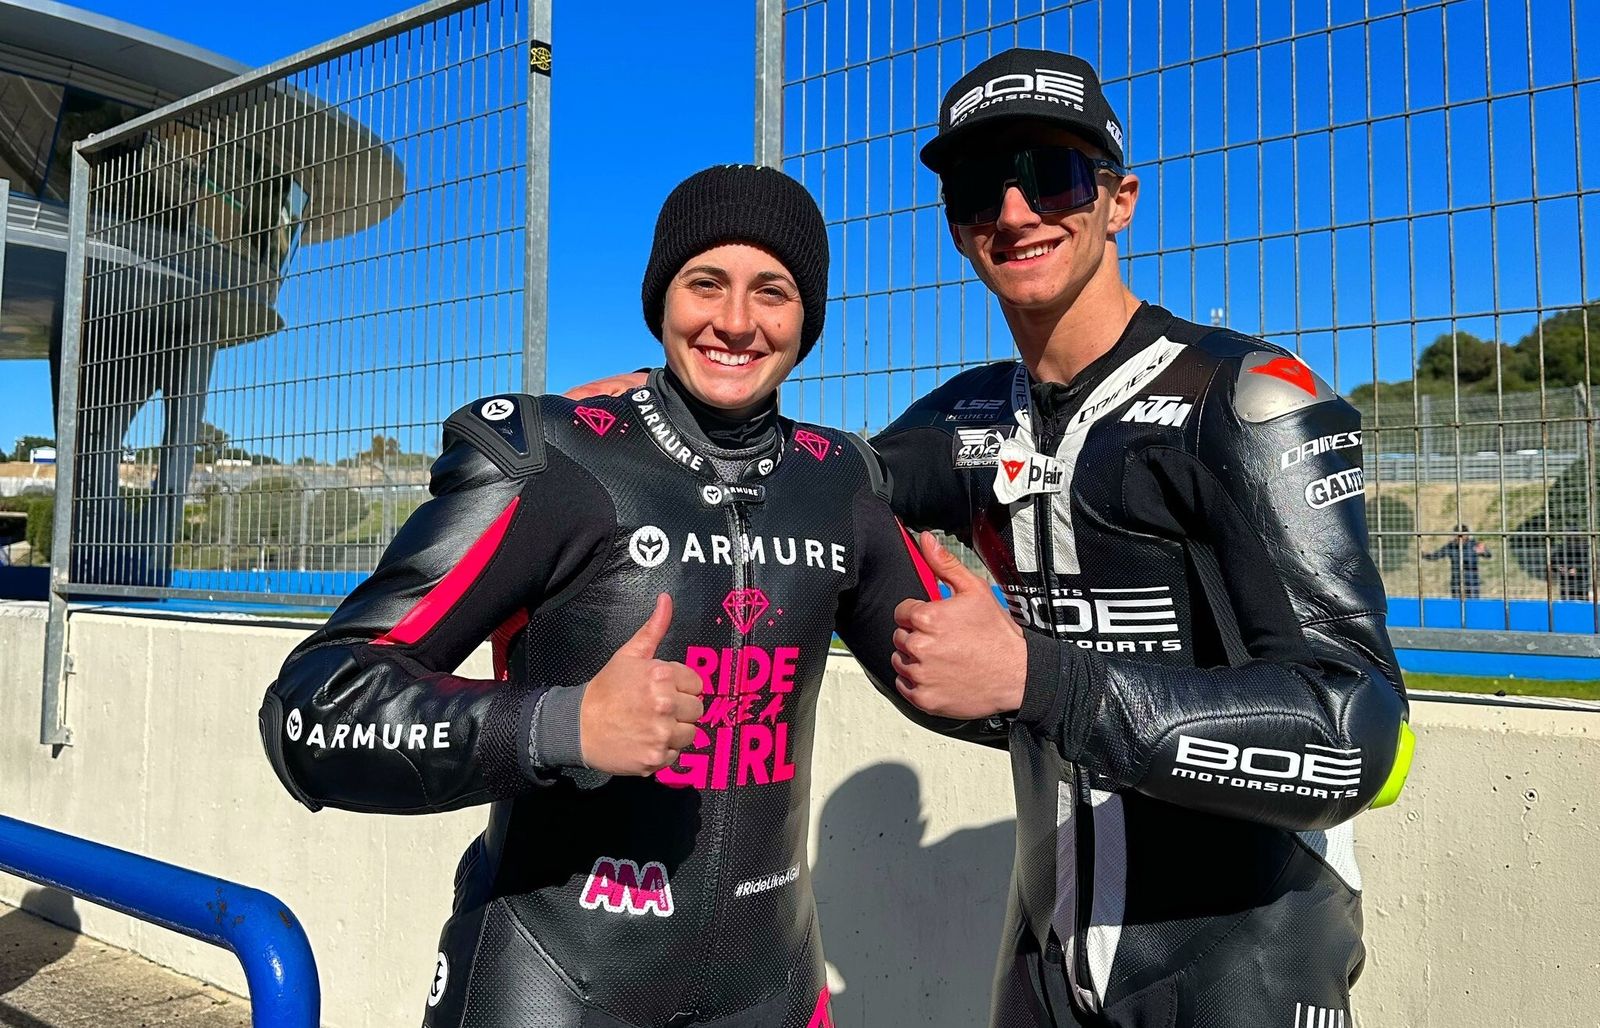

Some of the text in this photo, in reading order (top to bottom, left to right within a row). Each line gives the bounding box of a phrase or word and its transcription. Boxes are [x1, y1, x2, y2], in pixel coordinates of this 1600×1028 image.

[950, 69, 1085, 125] BOE
[953, 399, 1006, 410] LS2
[1121, 395, 1192, 427] KTM
[638, 402, 705, 472] ARMURE
[1281, 430, 1363, 470] DAINES
[724, 486, 759, 496] ARMURE
[681, 533, 847, 573] ARMURE
[686, 645, 800, 695] RIDE
[697, 693, 762, 728] IKE
[306, 721, 451, 750] ARMURE
[655, 722, 796, 789] GIRL
[1175, 734, 1362, 786] BOE
[1171, 767, 1359, 799] MOTORSPORTS
